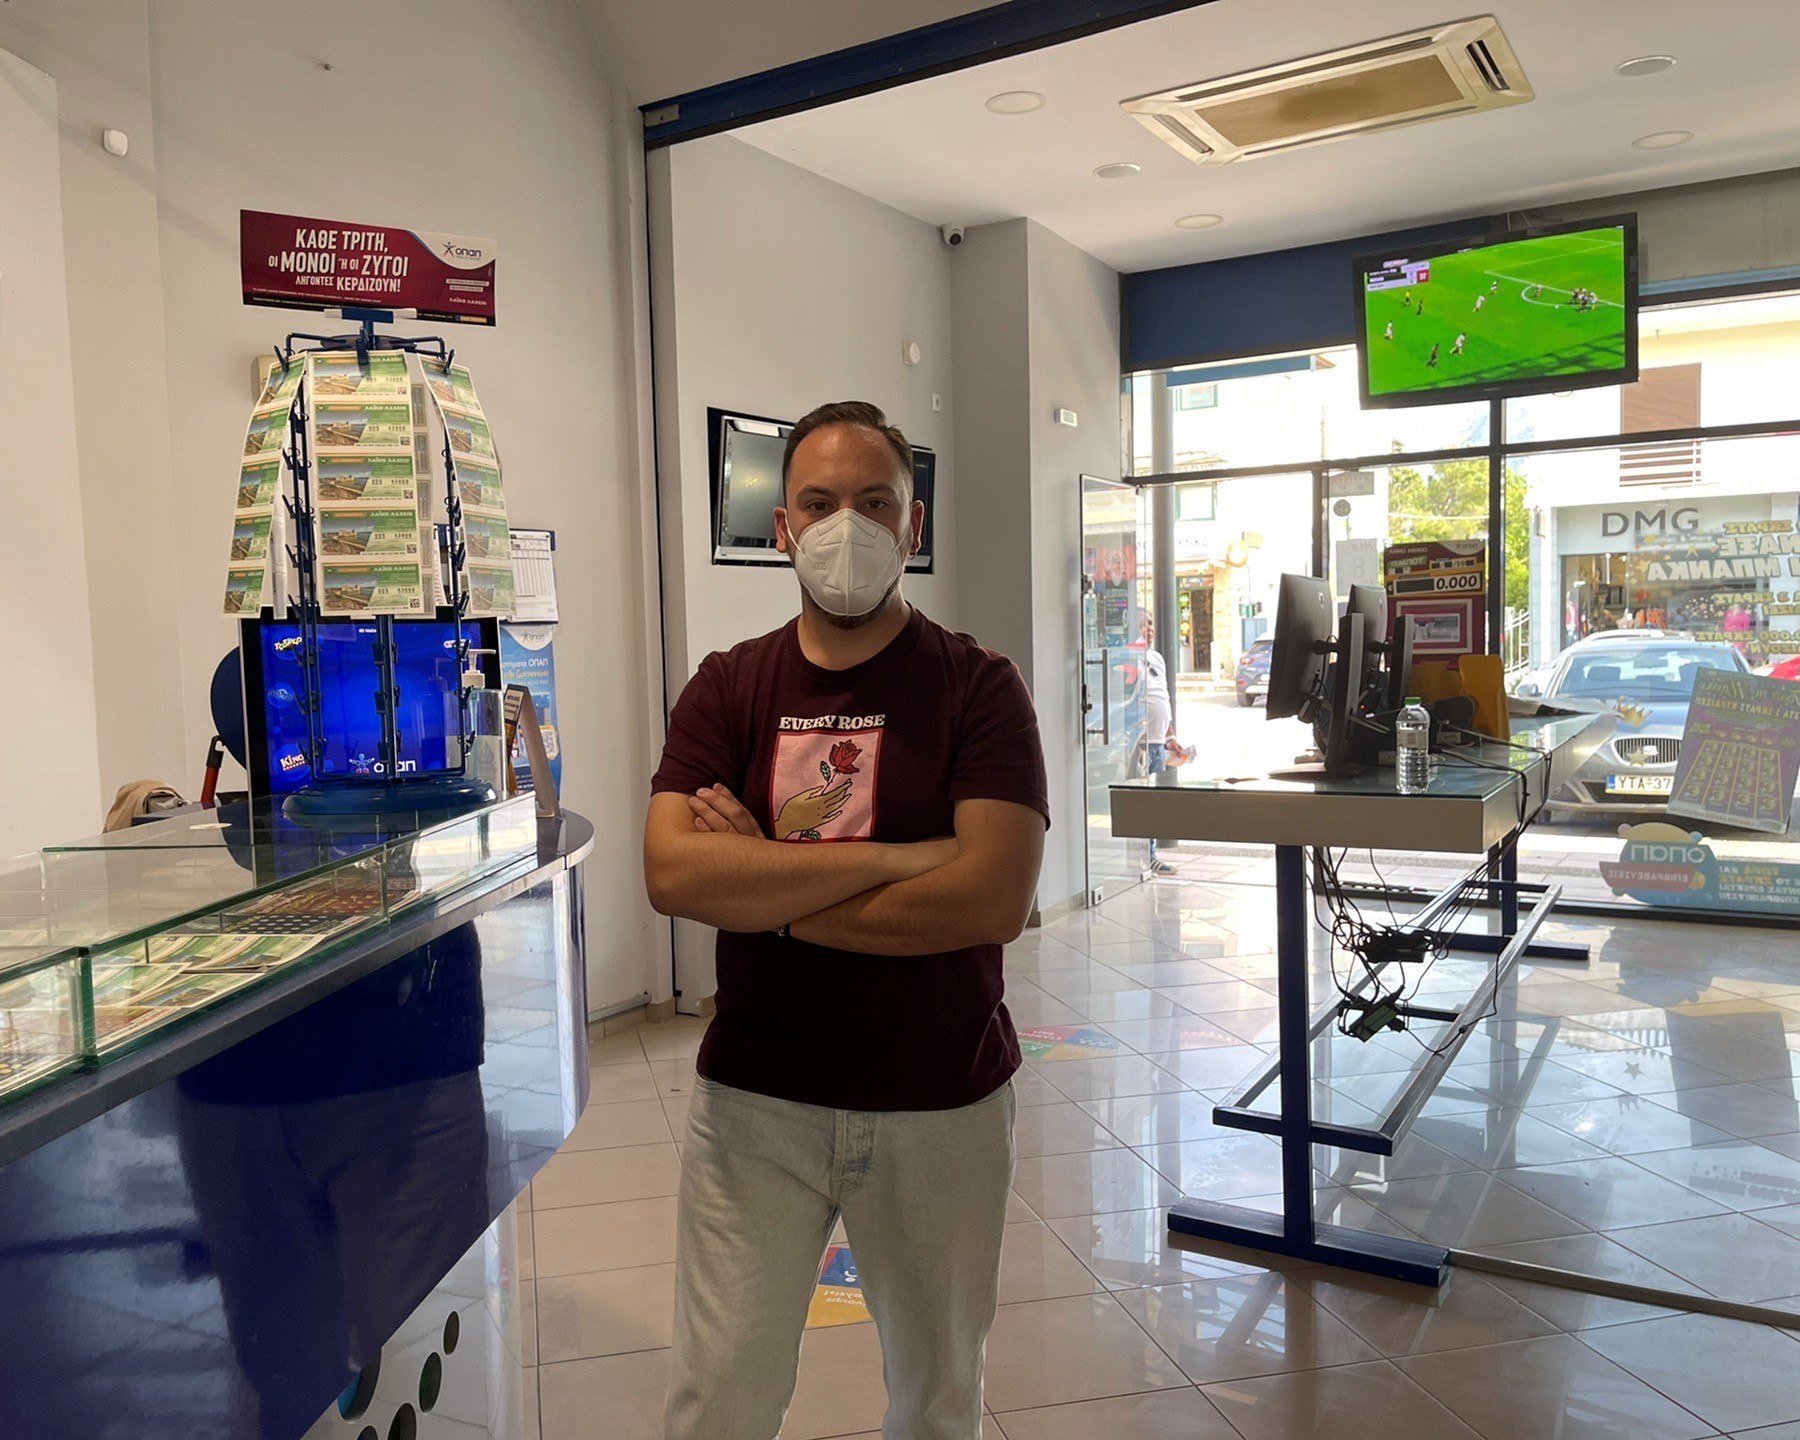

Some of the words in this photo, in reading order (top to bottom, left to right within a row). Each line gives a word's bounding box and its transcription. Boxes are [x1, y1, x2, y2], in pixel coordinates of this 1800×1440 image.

[295, 228, 338, 249] ΚΑΘΕ
[342, 231, 389, 253] ΤΡΙΤΗ,
[268, 255, 278, 267] ΟΙ
[280, 251, 336, 274] ΜΟΝΟΙ
[349, 258, 359, 270] ΟΙ
[361, 255, 409, 277] ΖΥΓΟΙ
[295, 275, 334, 287] ΛΗΓΟΝΤΕΣ
[336, 278, 402, 292] ΚΕΡΔΙΖΟΥΝ!
[1602, 508, 1699, 536] DMG
[1436, 575, 1477, 590] 0.000
[779, 715, 837, 730] EVERY
[837, 714, 886, 730] ROSE
